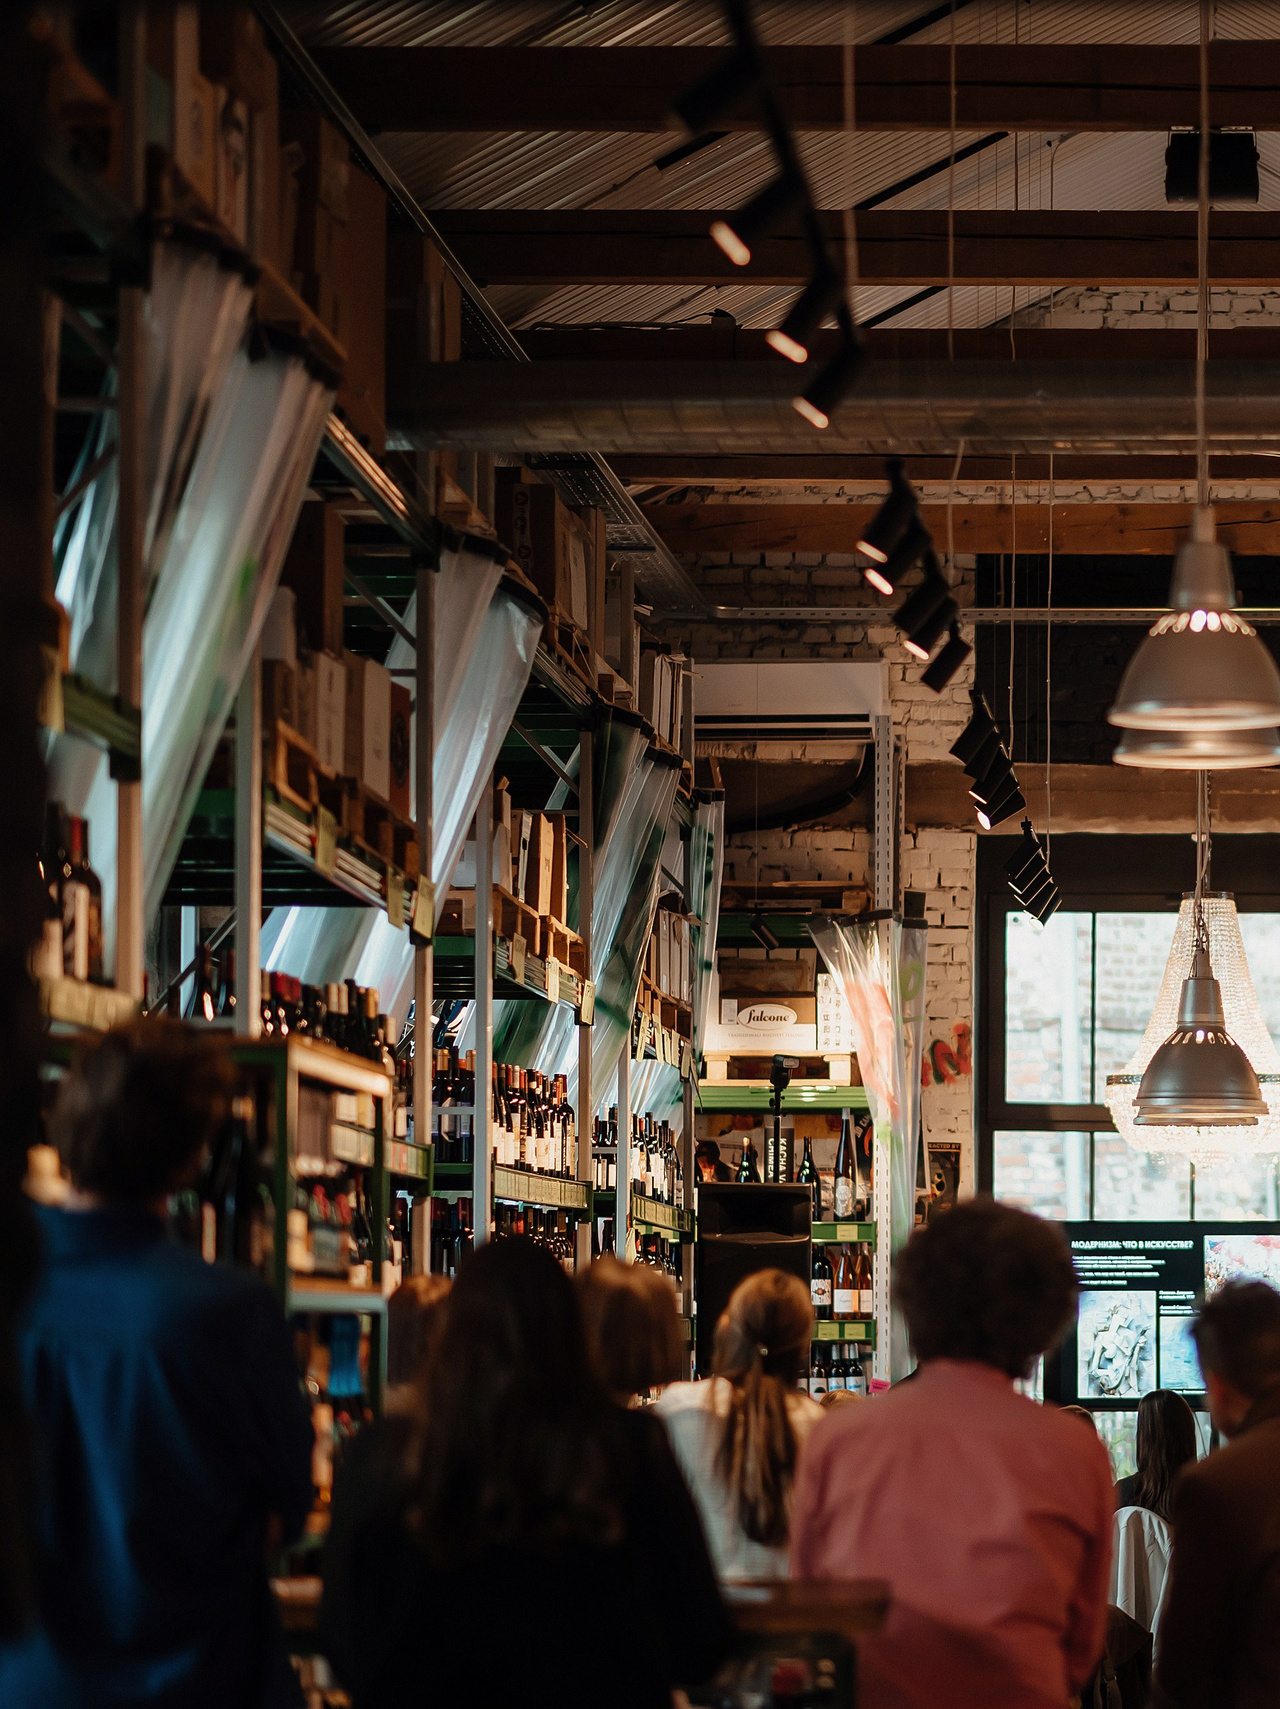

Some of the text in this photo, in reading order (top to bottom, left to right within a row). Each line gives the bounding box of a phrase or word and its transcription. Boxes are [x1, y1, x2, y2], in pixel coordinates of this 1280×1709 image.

[747, 1009, 790, 1024] falcone
[1071, 1240, 1194, 1249] МОДЕРНИЗМ: ЧТО В ИСКУССТВЕ?
